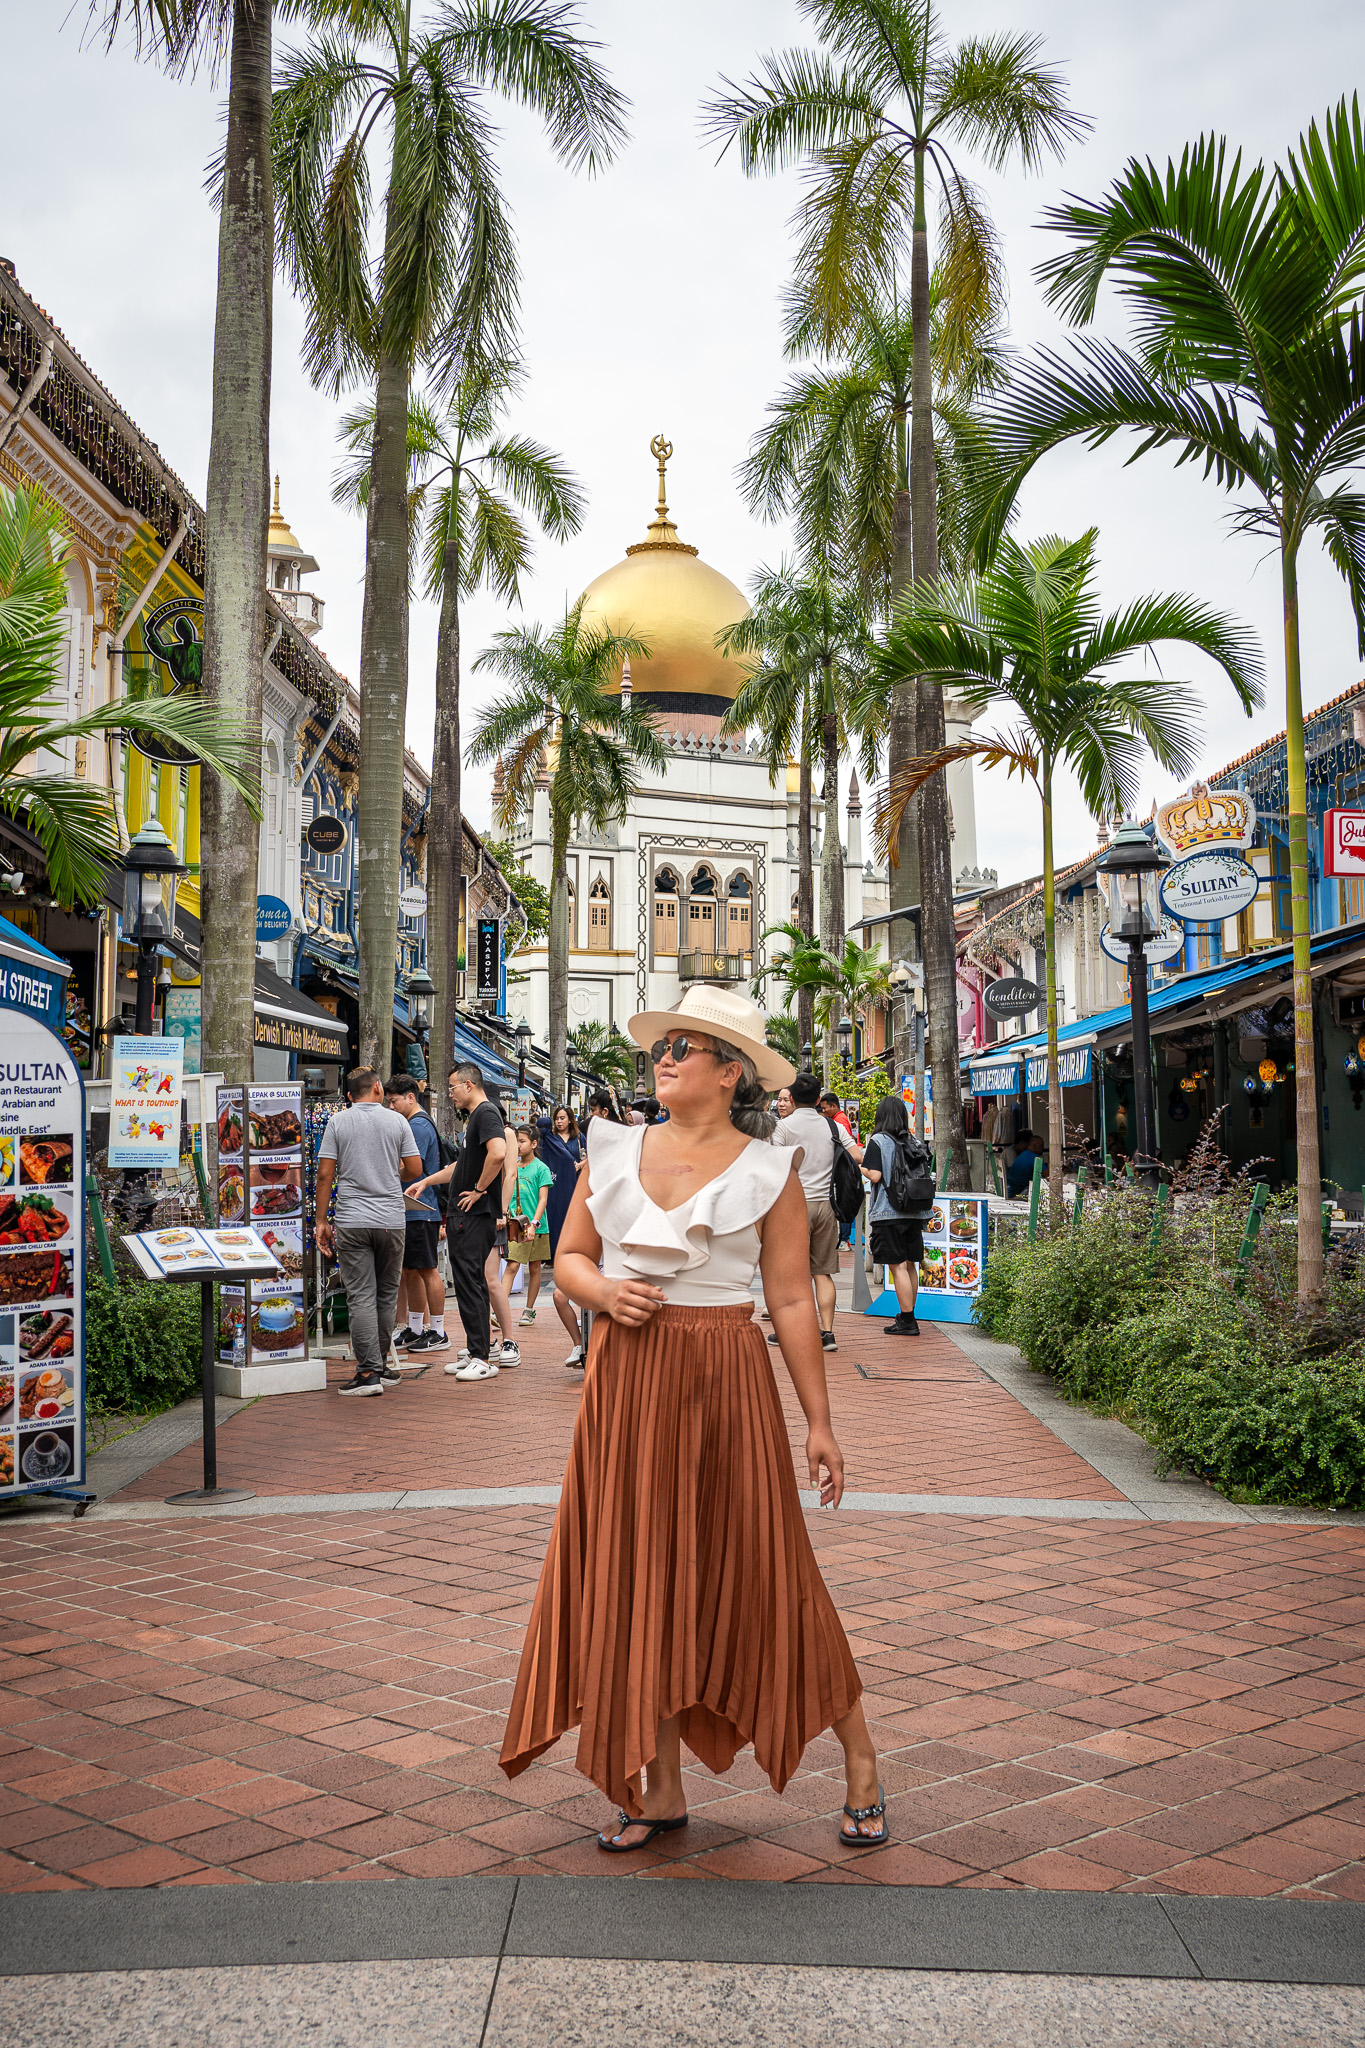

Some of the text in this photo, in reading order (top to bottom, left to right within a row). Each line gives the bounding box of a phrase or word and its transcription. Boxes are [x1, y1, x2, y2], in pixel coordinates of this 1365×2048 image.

[153, 601, 192, 621] AUTHENTIC
[1180, 875, 1239, 897] SULTAN
[1173, 891, 1252, 909] Traditional Turkish Restaurant
[484, 933, 492, 987] AYASOFYA
[10, 972, 53, 1011] STREET
[989, 986, 1037, 1002] konditori
[254, 1016, 280, 1045] Derwish
[281, 1022, 302, 1049] Turkish
[972, 1067, 1015, 1092] SULTAN RESTAURANT
[14, 1085, 62, 1095] Restaurant
[248, 1091, 268, 1099] LEPAK
[276, 1090, 300, 1098] SULTAN
[2, 1098, 55, 1109] Arabian and
[115, 1099, 179, 1107] WHAT IS TOUTING?
[29, 1421, 50, 1429] GORENG
[51, 1417, 76, 1425] KAMPONG
[27, 1477, 67, 1489] TURKISH COFFEE
